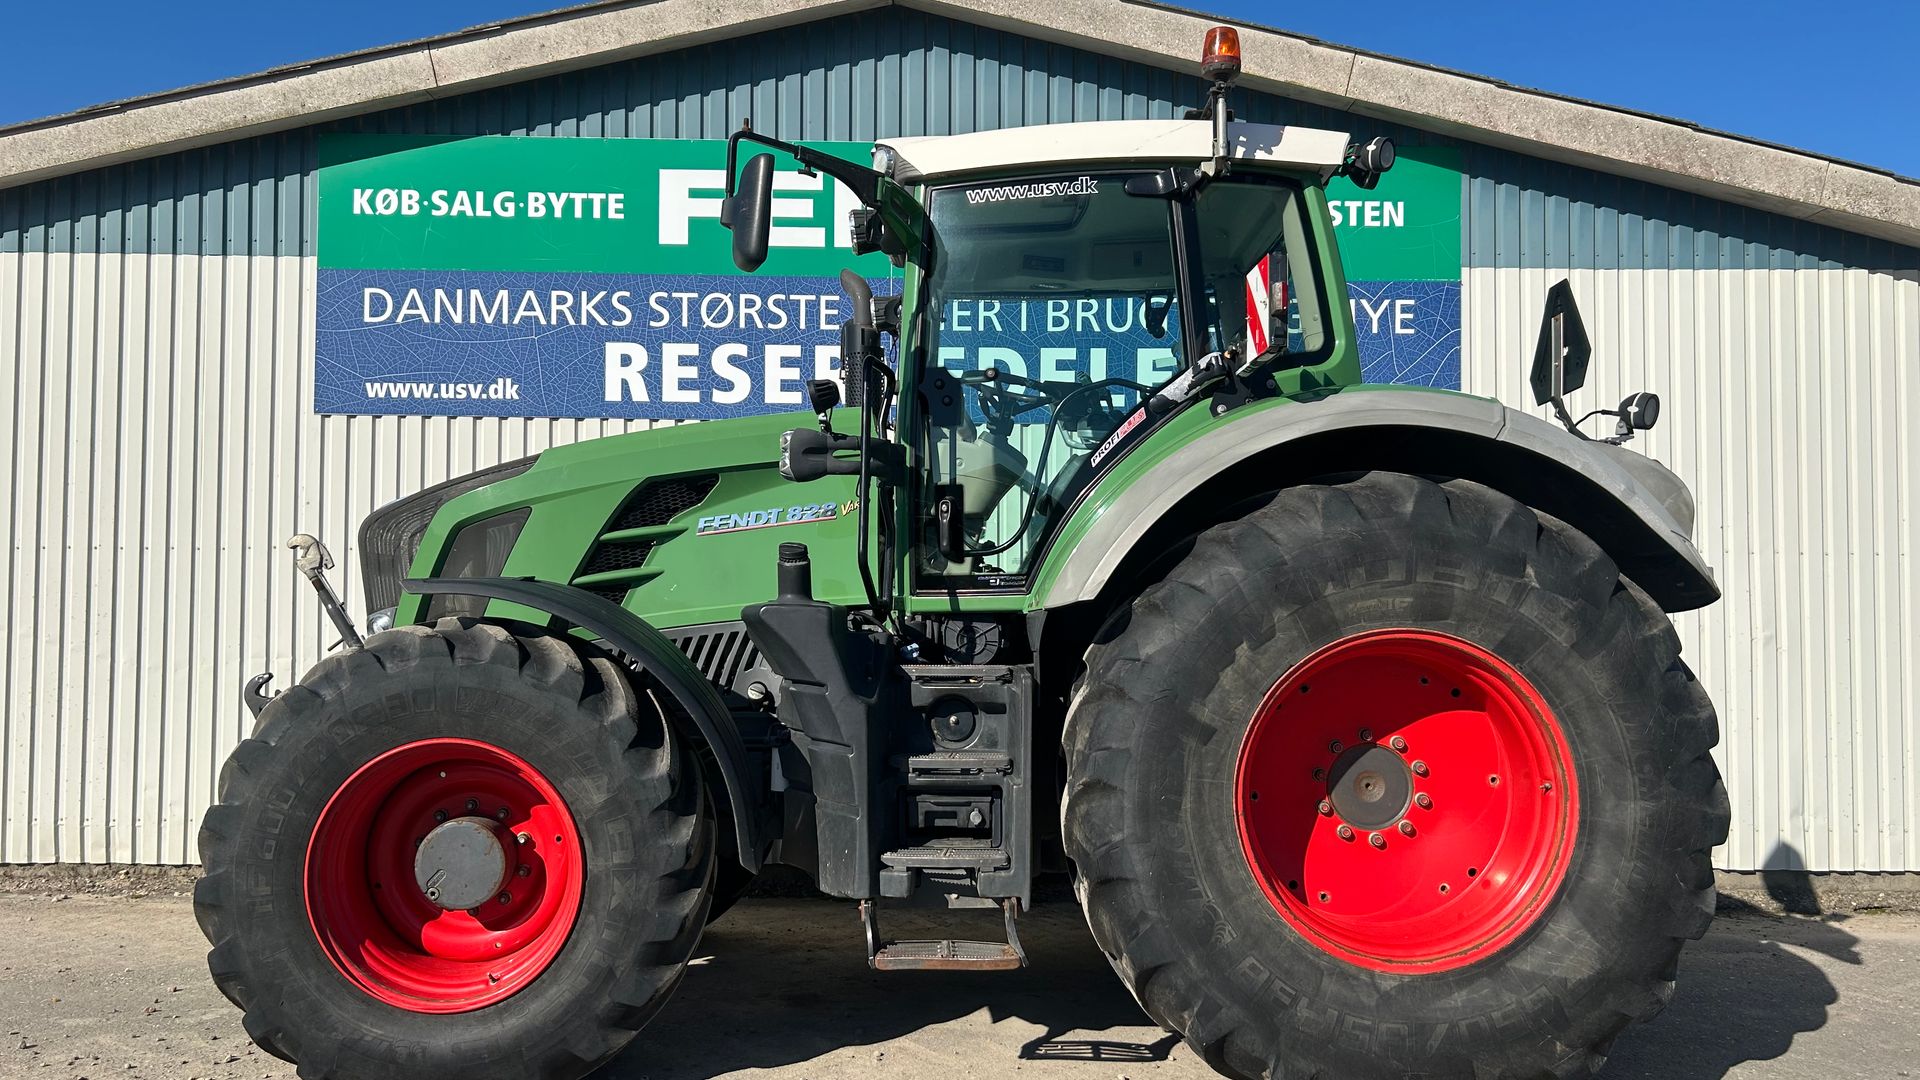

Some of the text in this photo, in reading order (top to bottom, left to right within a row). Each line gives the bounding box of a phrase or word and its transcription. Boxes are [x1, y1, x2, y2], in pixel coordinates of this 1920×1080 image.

[966, 177, 1099, 204] www.usv.dk
[1326, 200, 1404, 227] STEN
[363, 287, 632, 326] DANMARKS
[649, 291, 841, 330] STØRSTE
[365, 377, 520, 400] www.usv.dk
[698, 507, 784, 533] FENDT
[786, 501, 837, 523] 828
